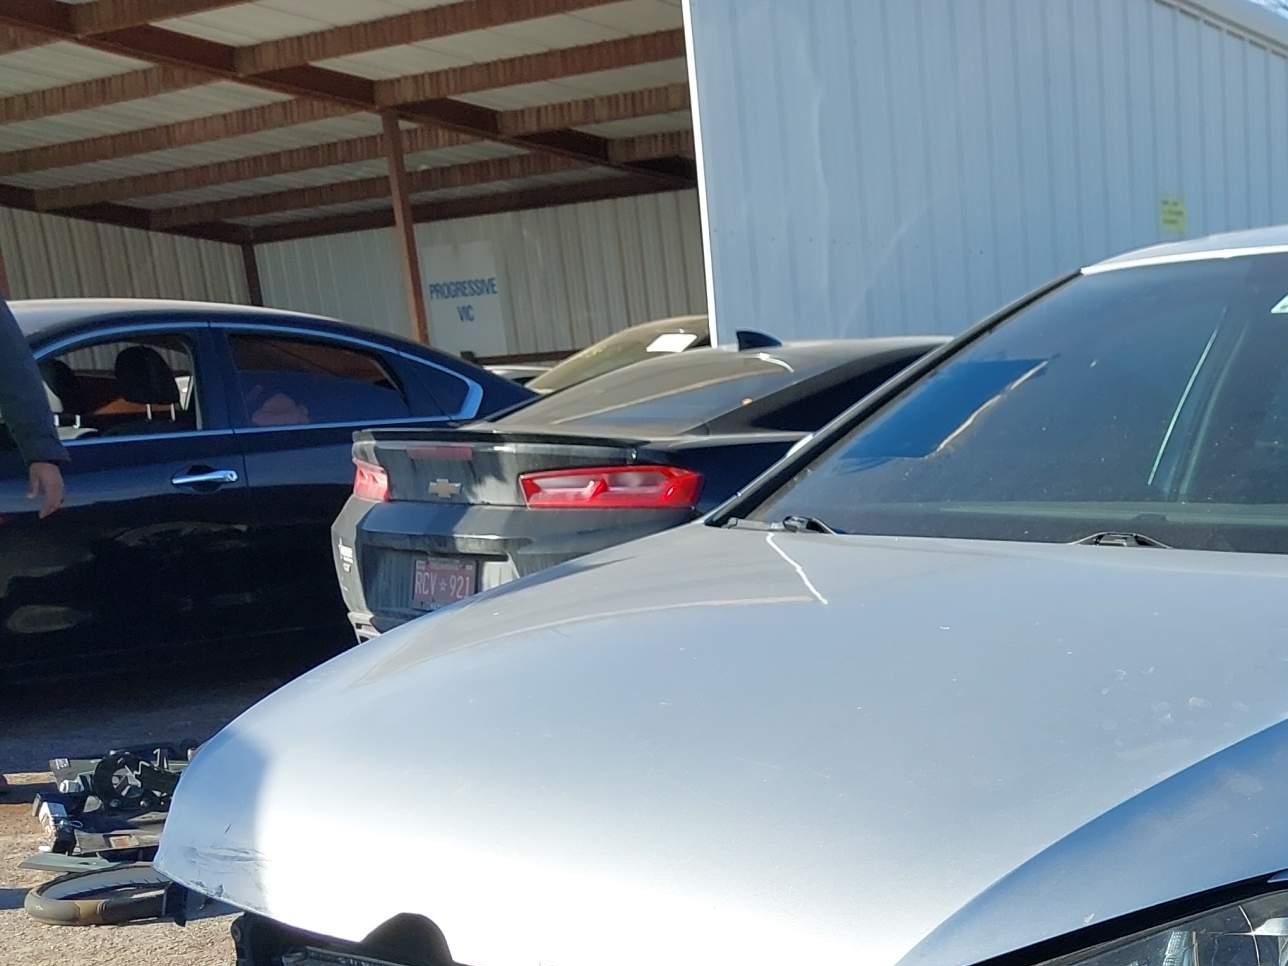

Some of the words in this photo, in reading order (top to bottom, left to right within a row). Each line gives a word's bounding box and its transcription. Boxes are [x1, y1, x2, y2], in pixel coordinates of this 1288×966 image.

[429, 277, 498, 300] PROGRESSIVE
[456, 304, 475, 322] VIC
[449, 574, 470, 599] 921
